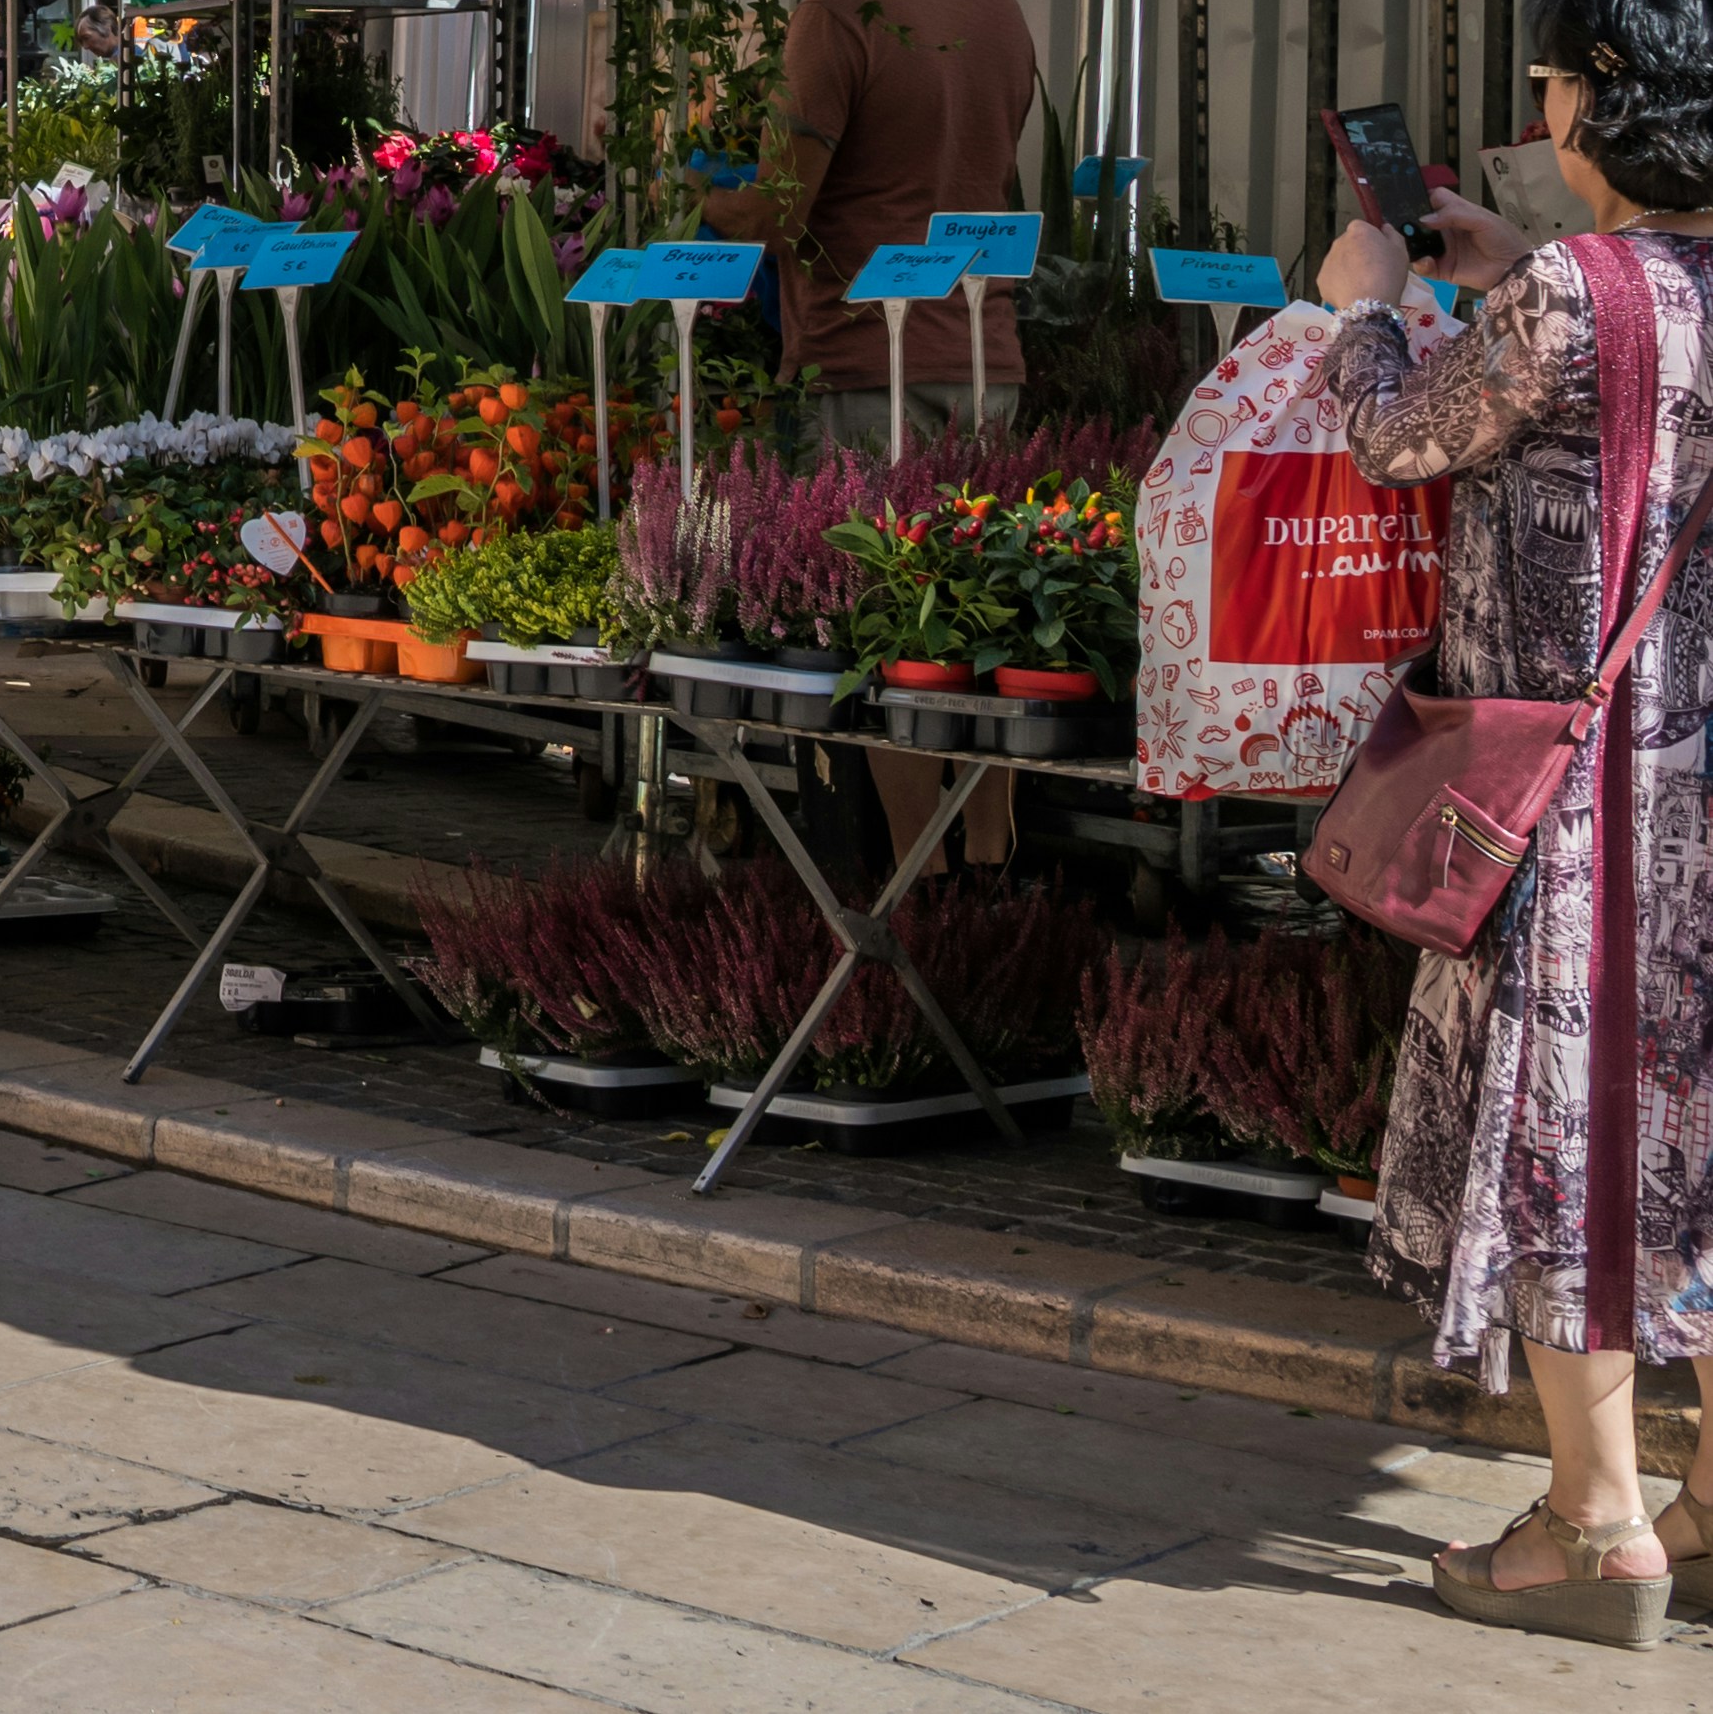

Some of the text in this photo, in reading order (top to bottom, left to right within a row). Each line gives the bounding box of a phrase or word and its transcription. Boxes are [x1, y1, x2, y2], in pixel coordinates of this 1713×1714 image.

[944, 220, 1018, 239] Bruyère
[662, 248, 741, 266] Bruyère
[885, 251, 956, 268] Bruyère
[1181, 256, 1256, 274] Piment
[1363, 627, 1431, 641] DPAM.COM
